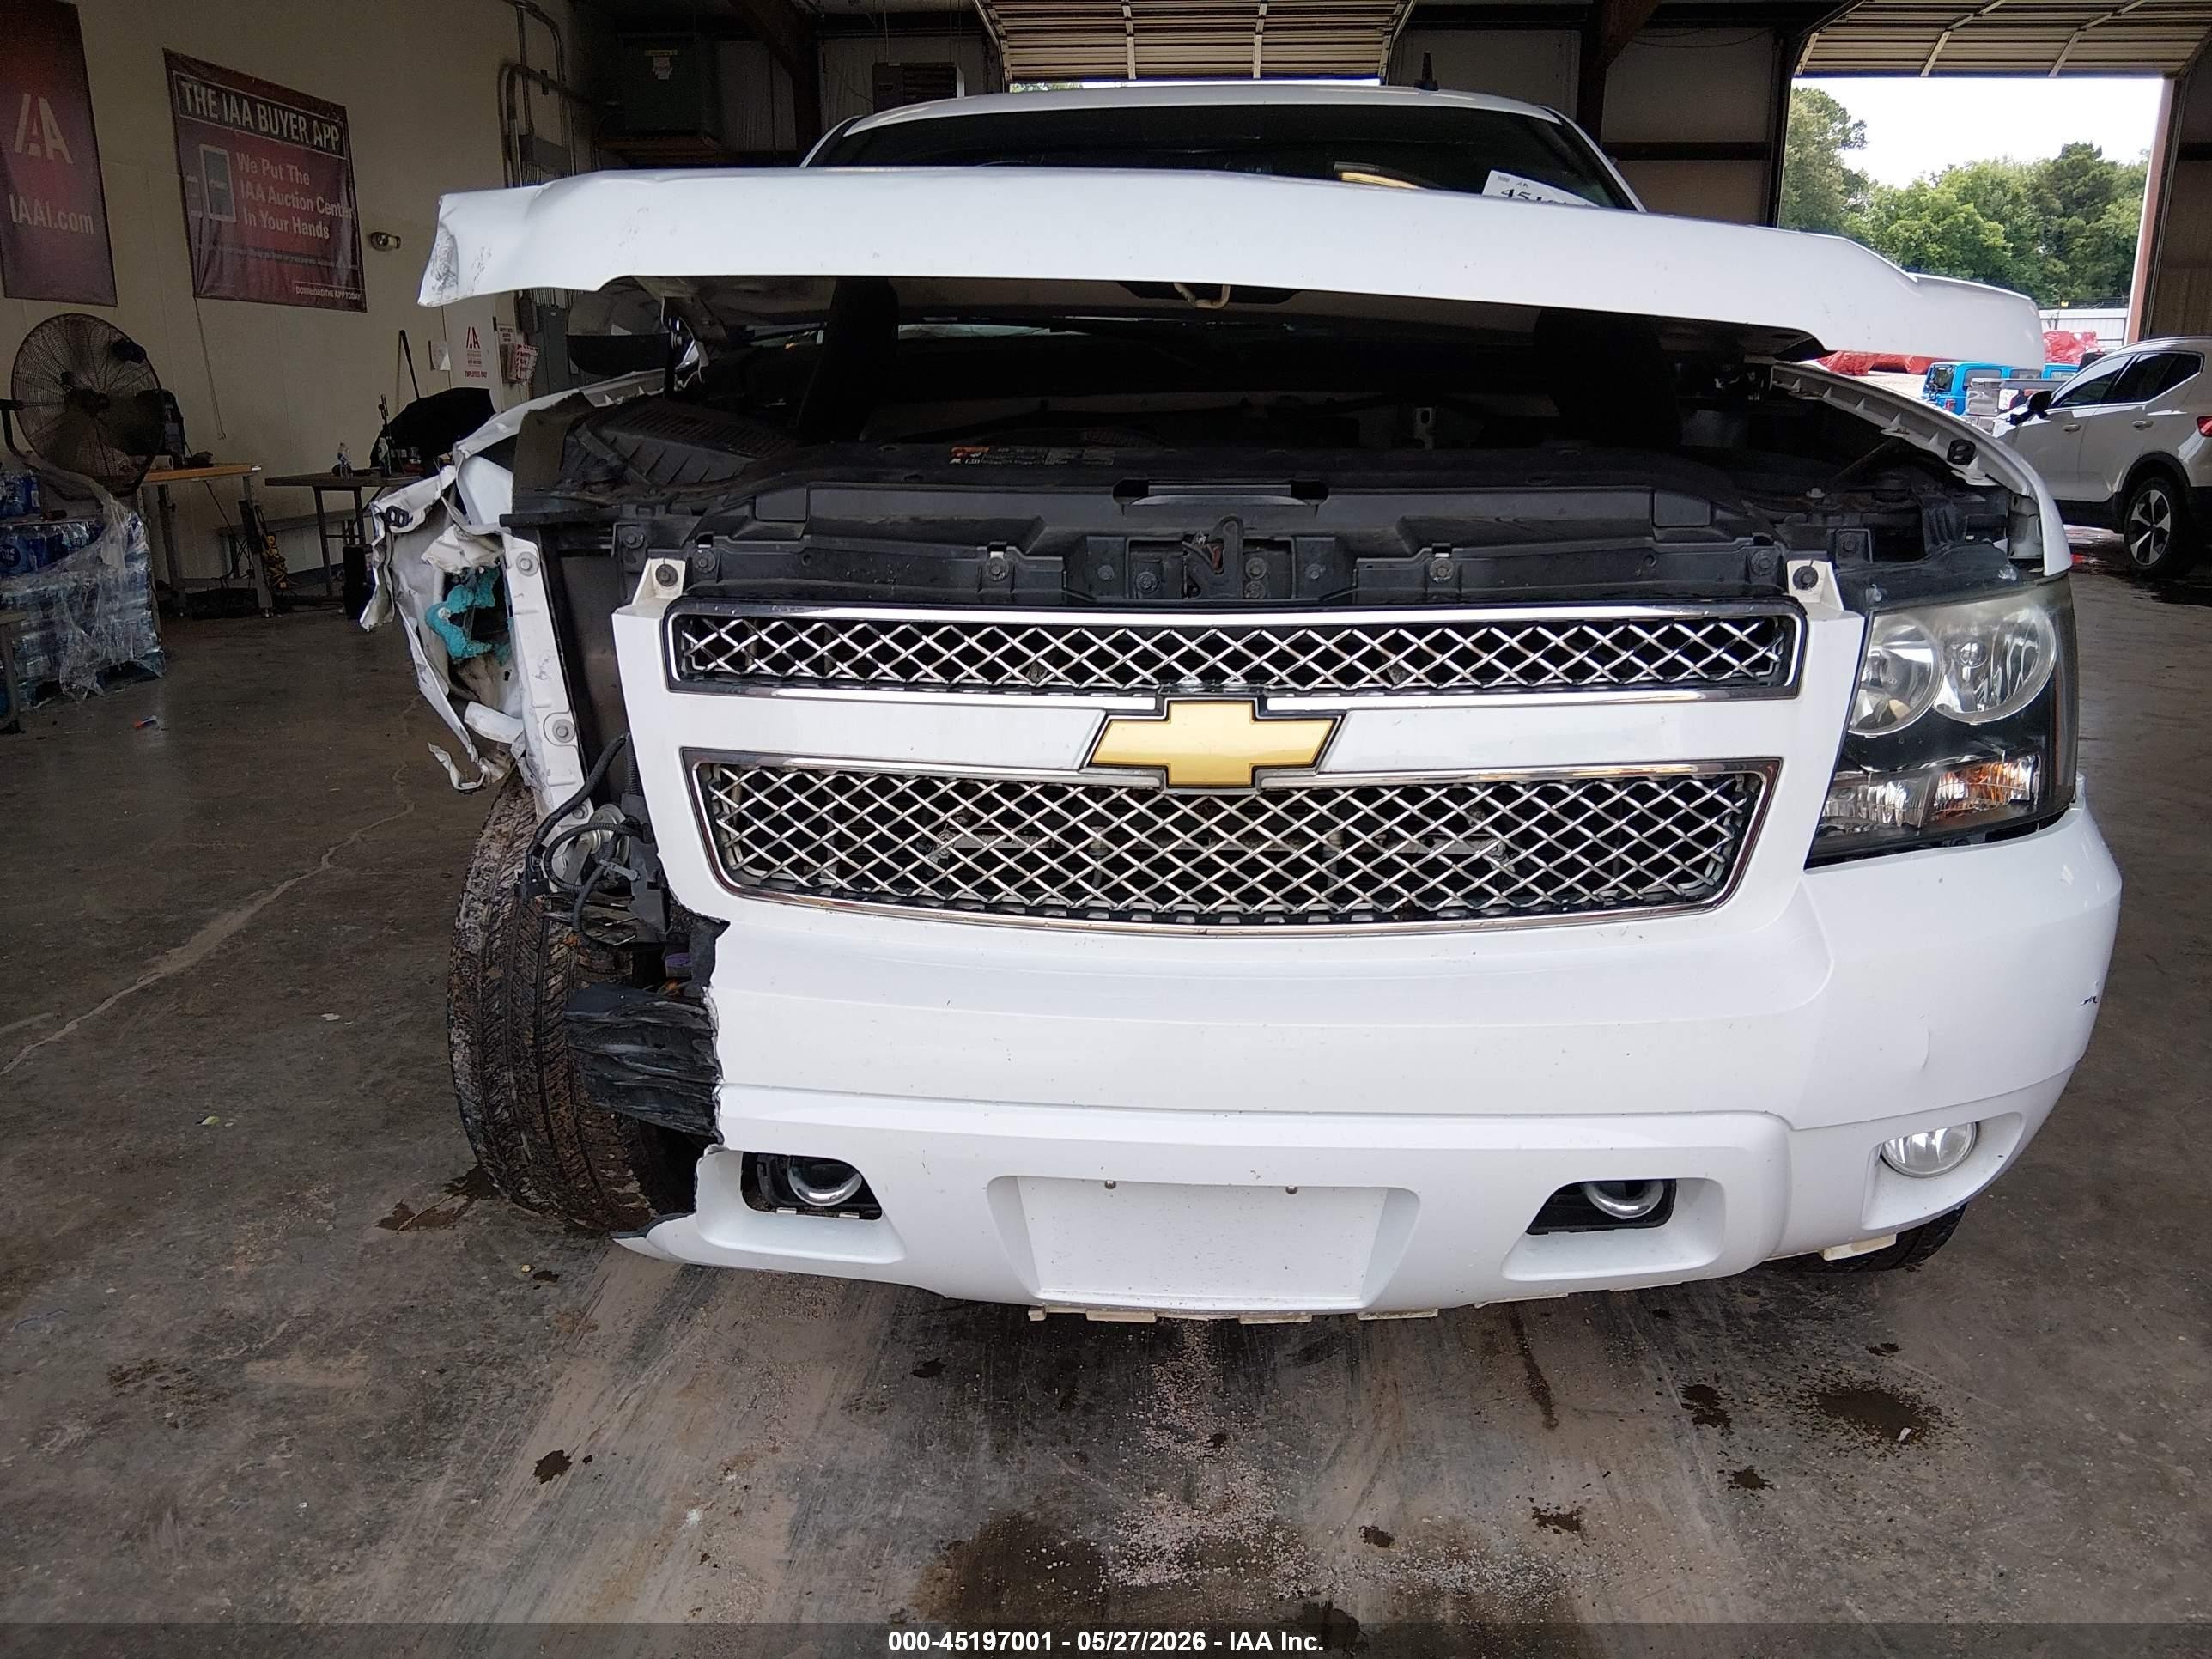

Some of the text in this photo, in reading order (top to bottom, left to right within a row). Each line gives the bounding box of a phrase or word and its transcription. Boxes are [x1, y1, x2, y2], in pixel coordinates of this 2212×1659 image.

[180, 81, 340, 152] THE IAA BUYER APP
[235, 151, 311, 187] We Put The
[9, 191, 94, 235] IAAI.com
[240, 179, 266, 203] IAA
[267, 185, 314, 214] Auction
[316, 196, 354, 221] Center
[242, 205, 331, 240] In Your Hands
